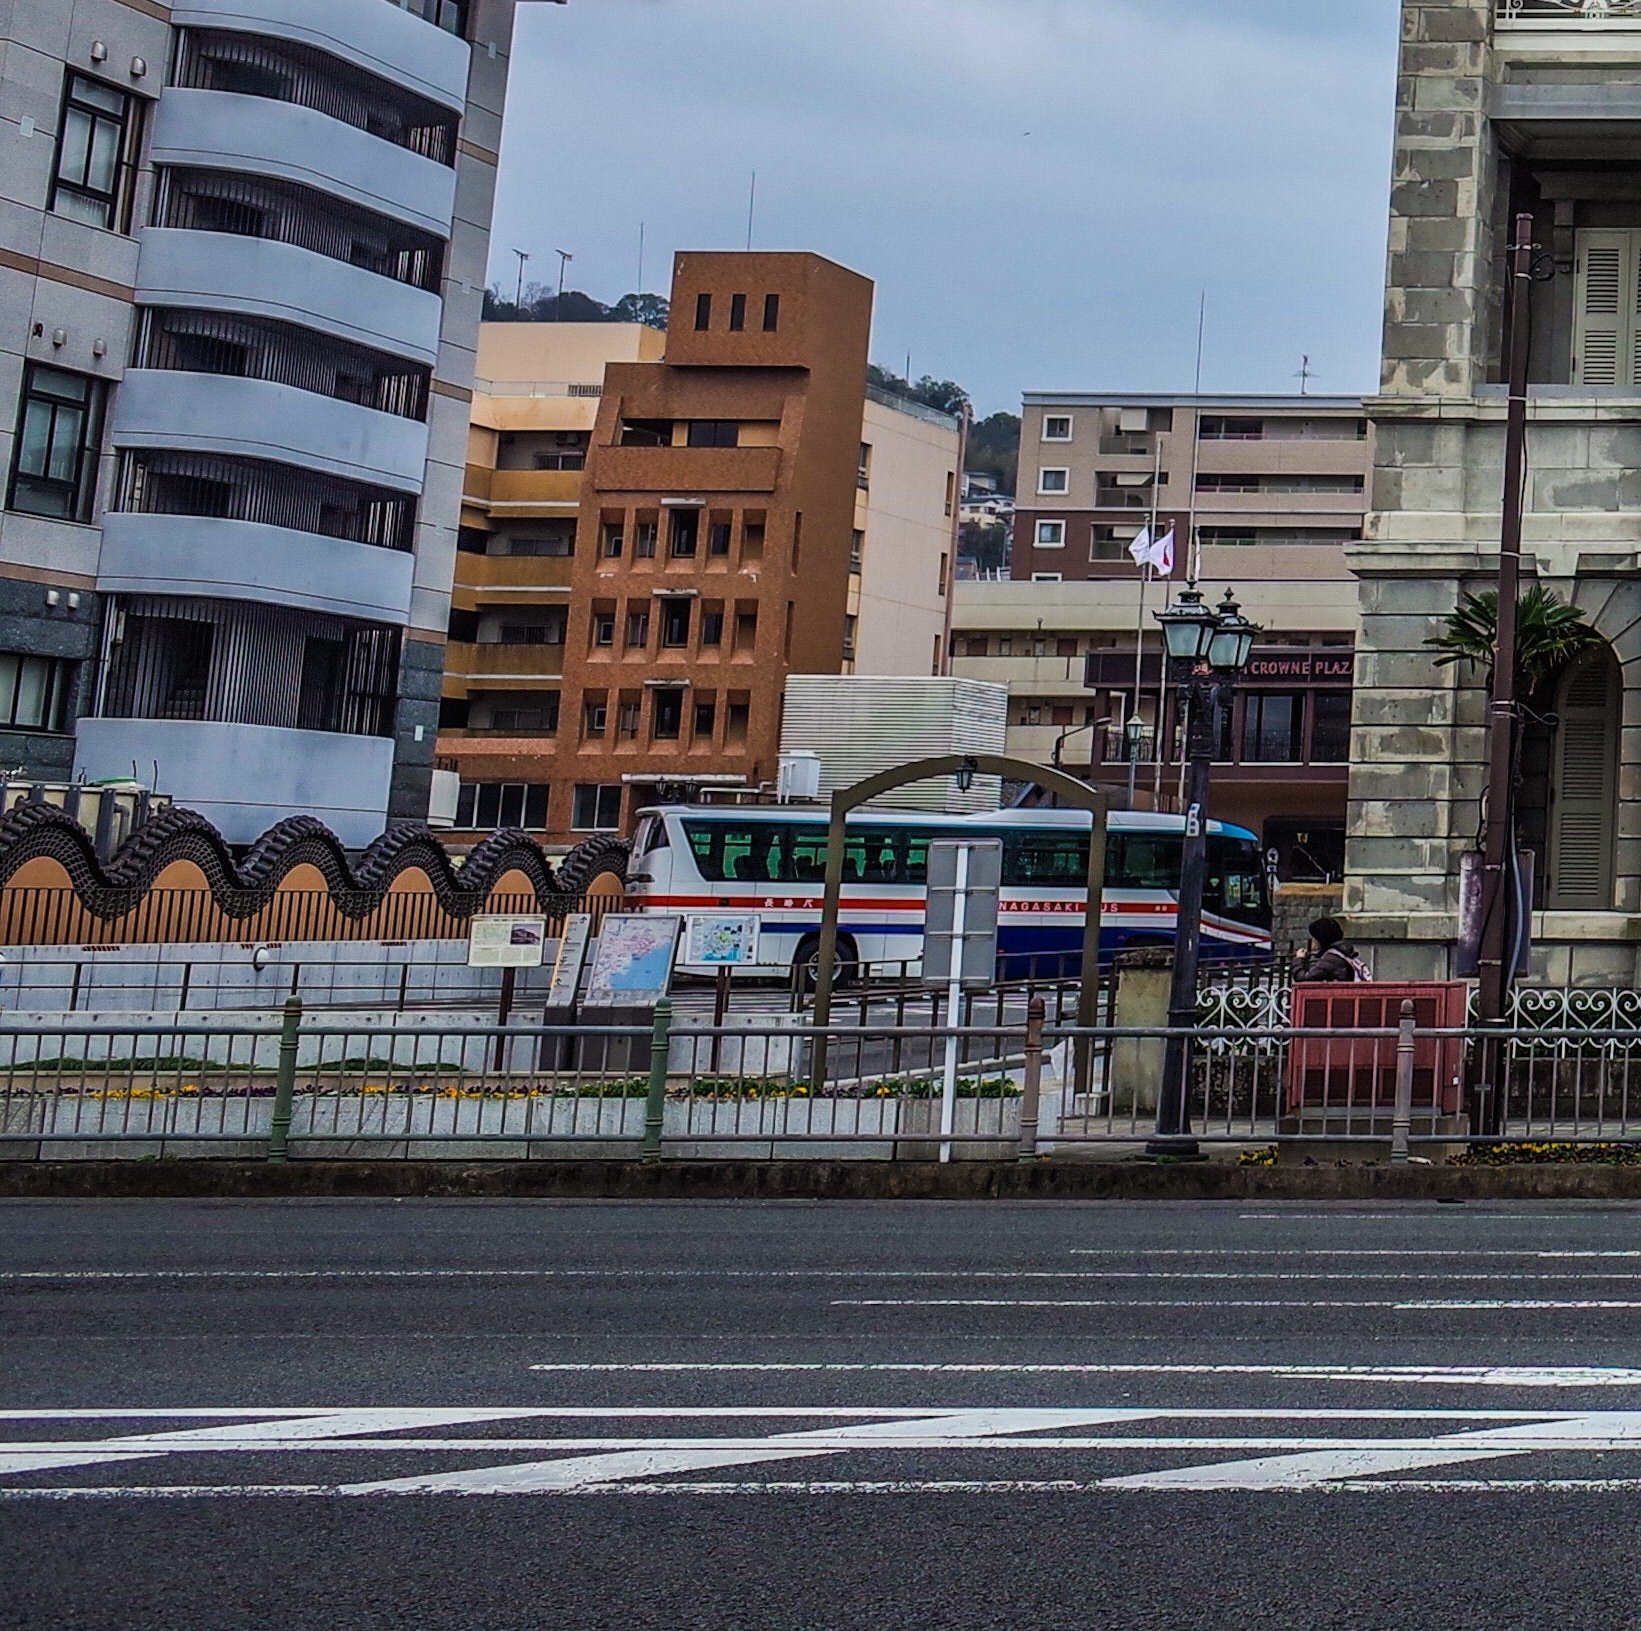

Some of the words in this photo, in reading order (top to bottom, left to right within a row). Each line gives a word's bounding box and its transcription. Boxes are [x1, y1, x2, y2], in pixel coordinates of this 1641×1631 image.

[1251, 661, 1310, 675] CROWNE
[1315, 661, 1352, 675] PLAZ
[999, 902, 1079, 912] NAGASAKI
